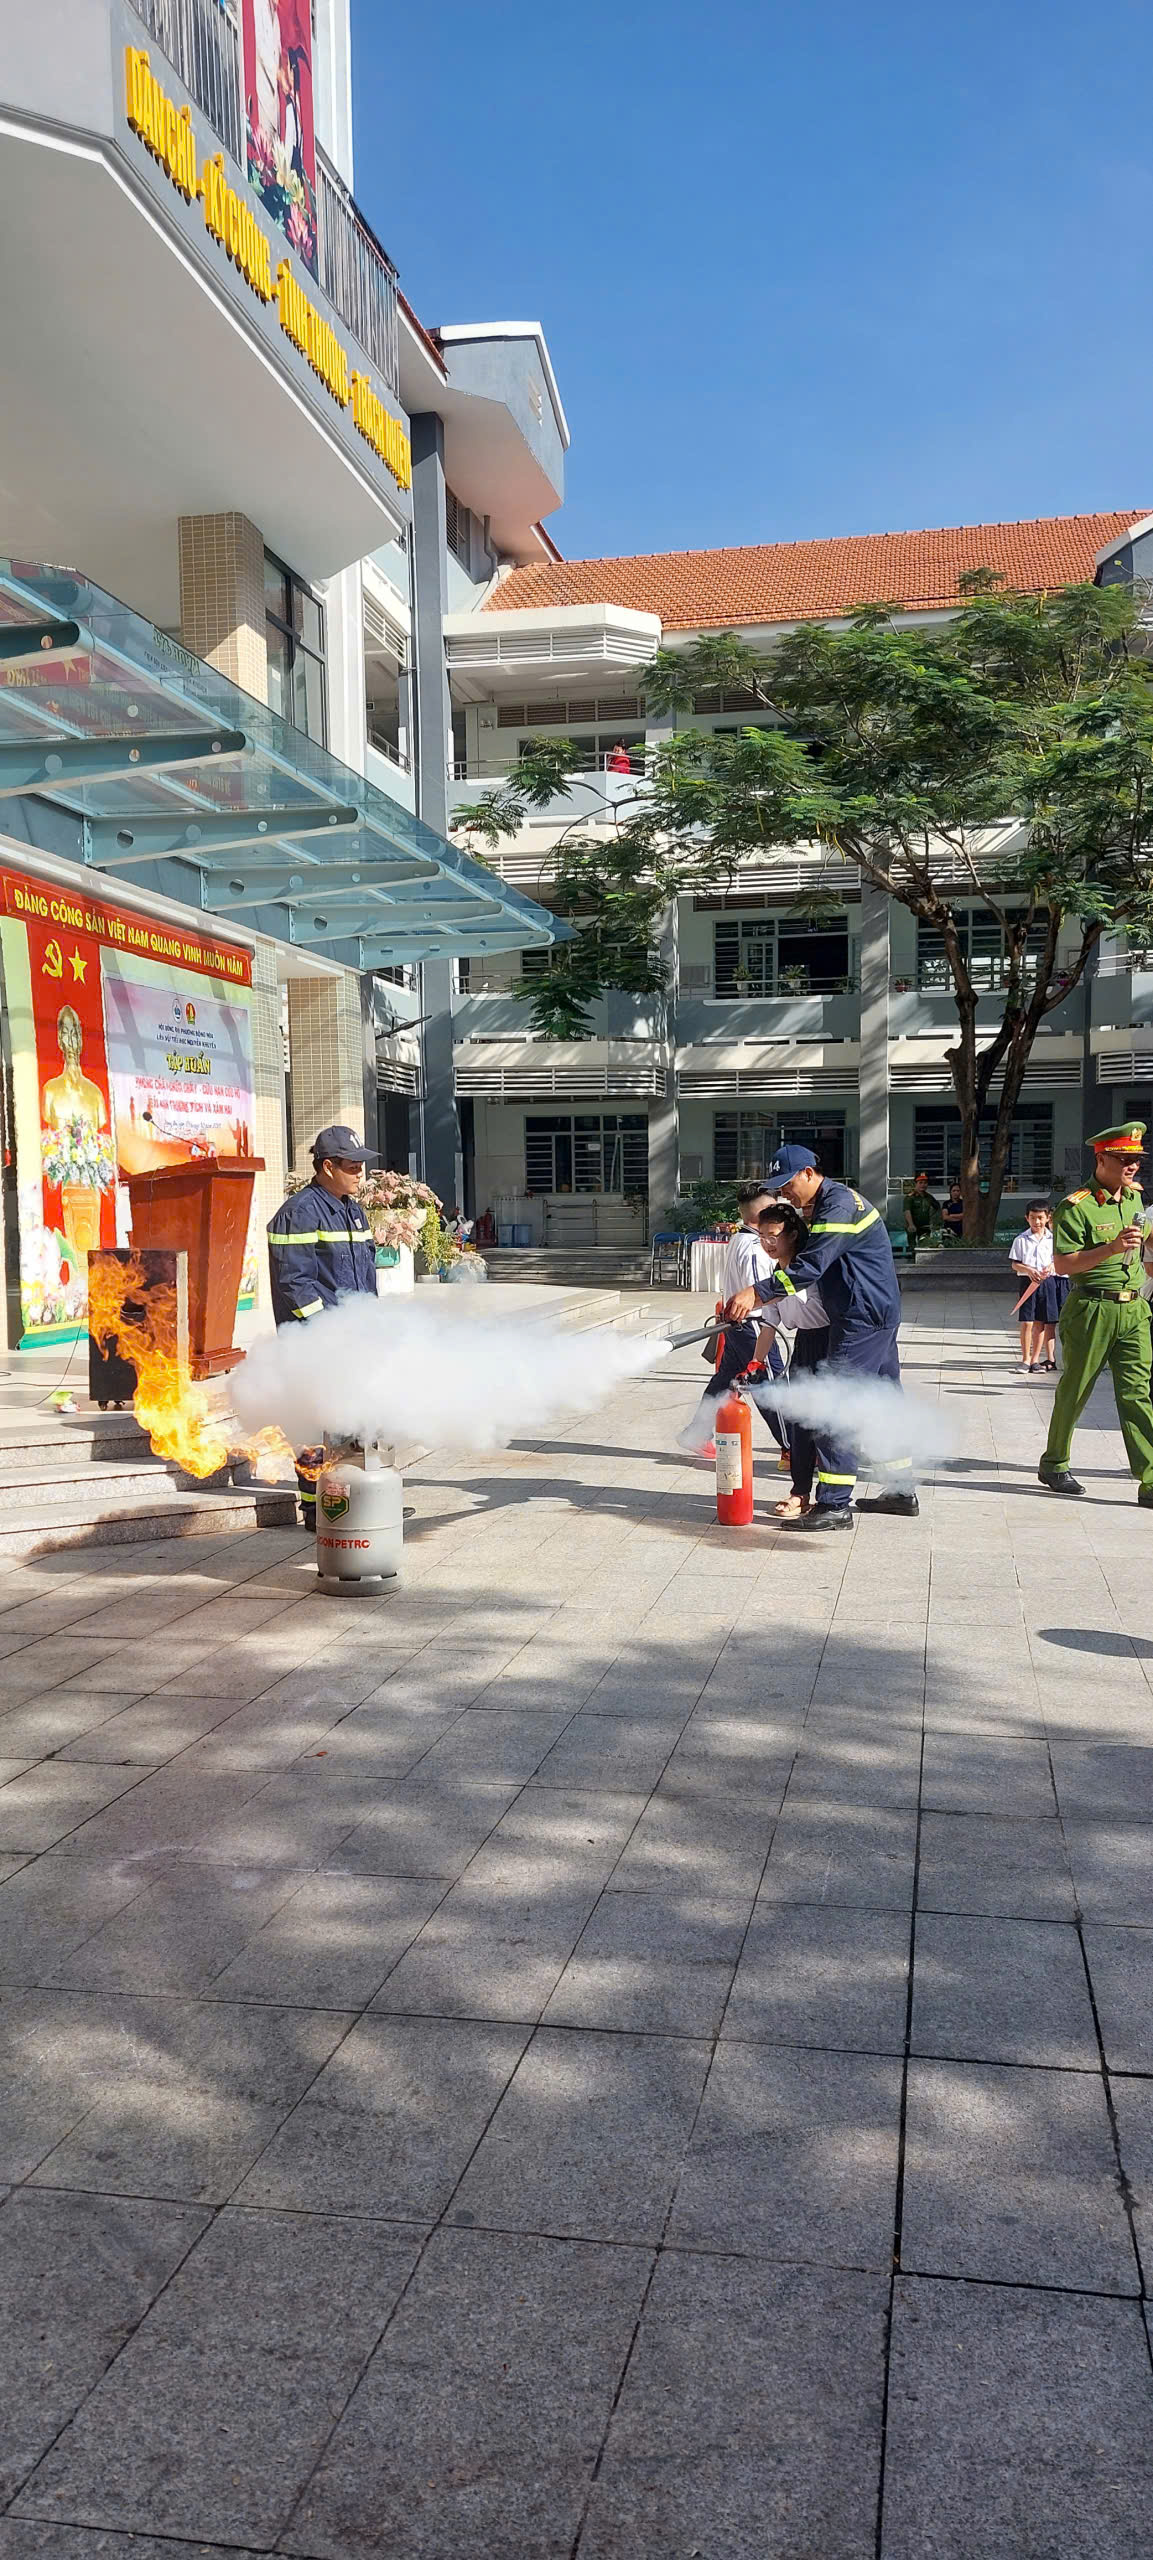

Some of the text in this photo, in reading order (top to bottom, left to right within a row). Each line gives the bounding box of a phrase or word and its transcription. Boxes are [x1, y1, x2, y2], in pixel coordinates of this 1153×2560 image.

[125, 45, 165, 160] DÂN
[162, 97, 197, 200] CHỦ
[226, 188, 272, 301] CƯƠNG
[306, 302, 349, 407] THƯƠNG
[351, 369, 385, 458] TRÁCH
[14, 885, 243, 977] ĐẢNG CỘNG SẢN VIỆT NAM QUANG VINH MUÔN NĂM
[323, 1496, 342, 1507] SP
